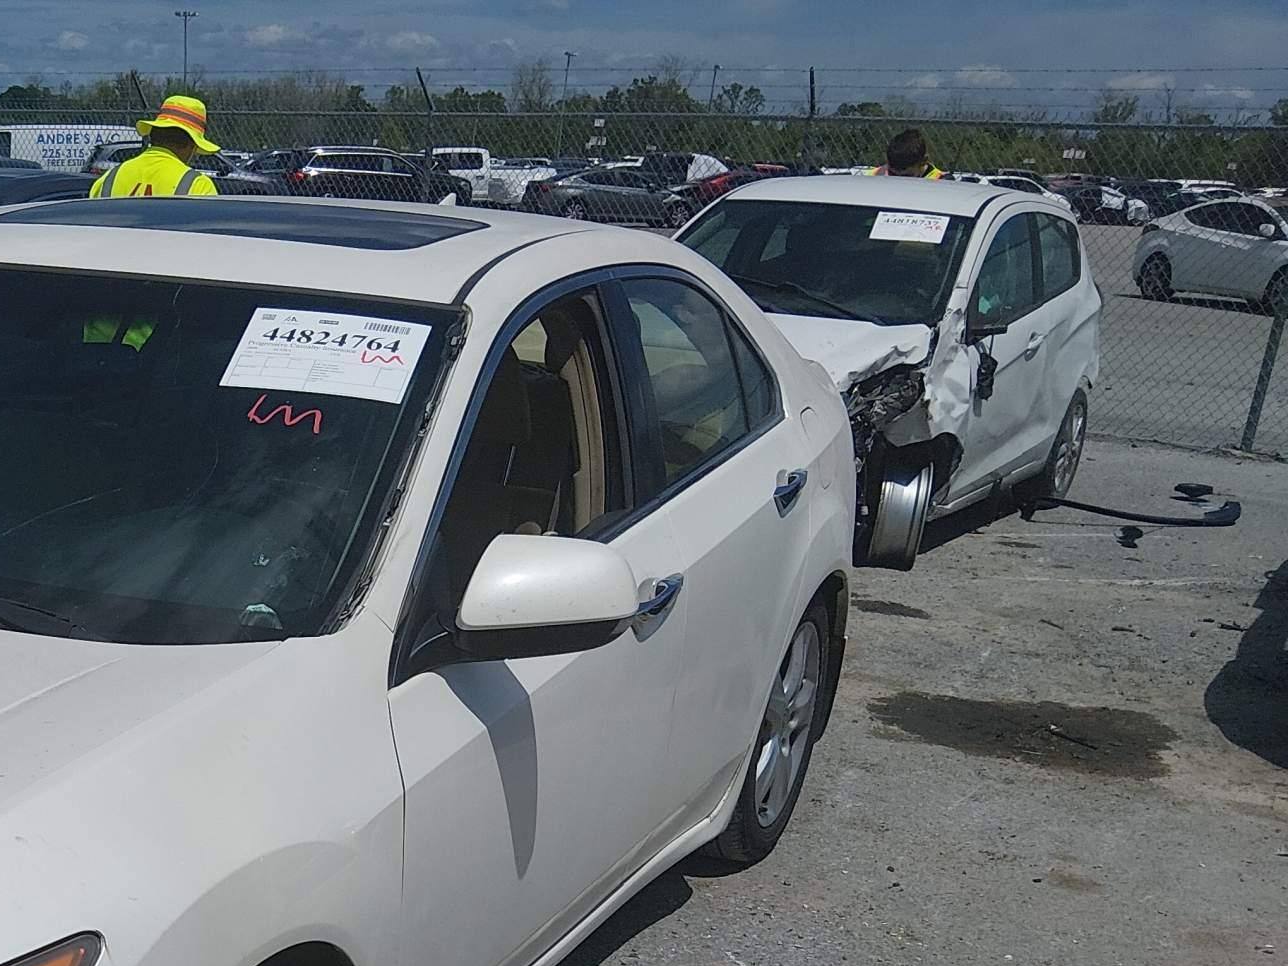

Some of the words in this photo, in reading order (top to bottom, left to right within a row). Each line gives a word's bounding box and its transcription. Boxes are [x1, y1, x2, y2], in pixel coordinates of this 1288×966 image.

[36, 132, 91, 145] ANDRE'S
[41, 148, 93, 159] 225-315-
[262, 327, 402, 353] 44824764
